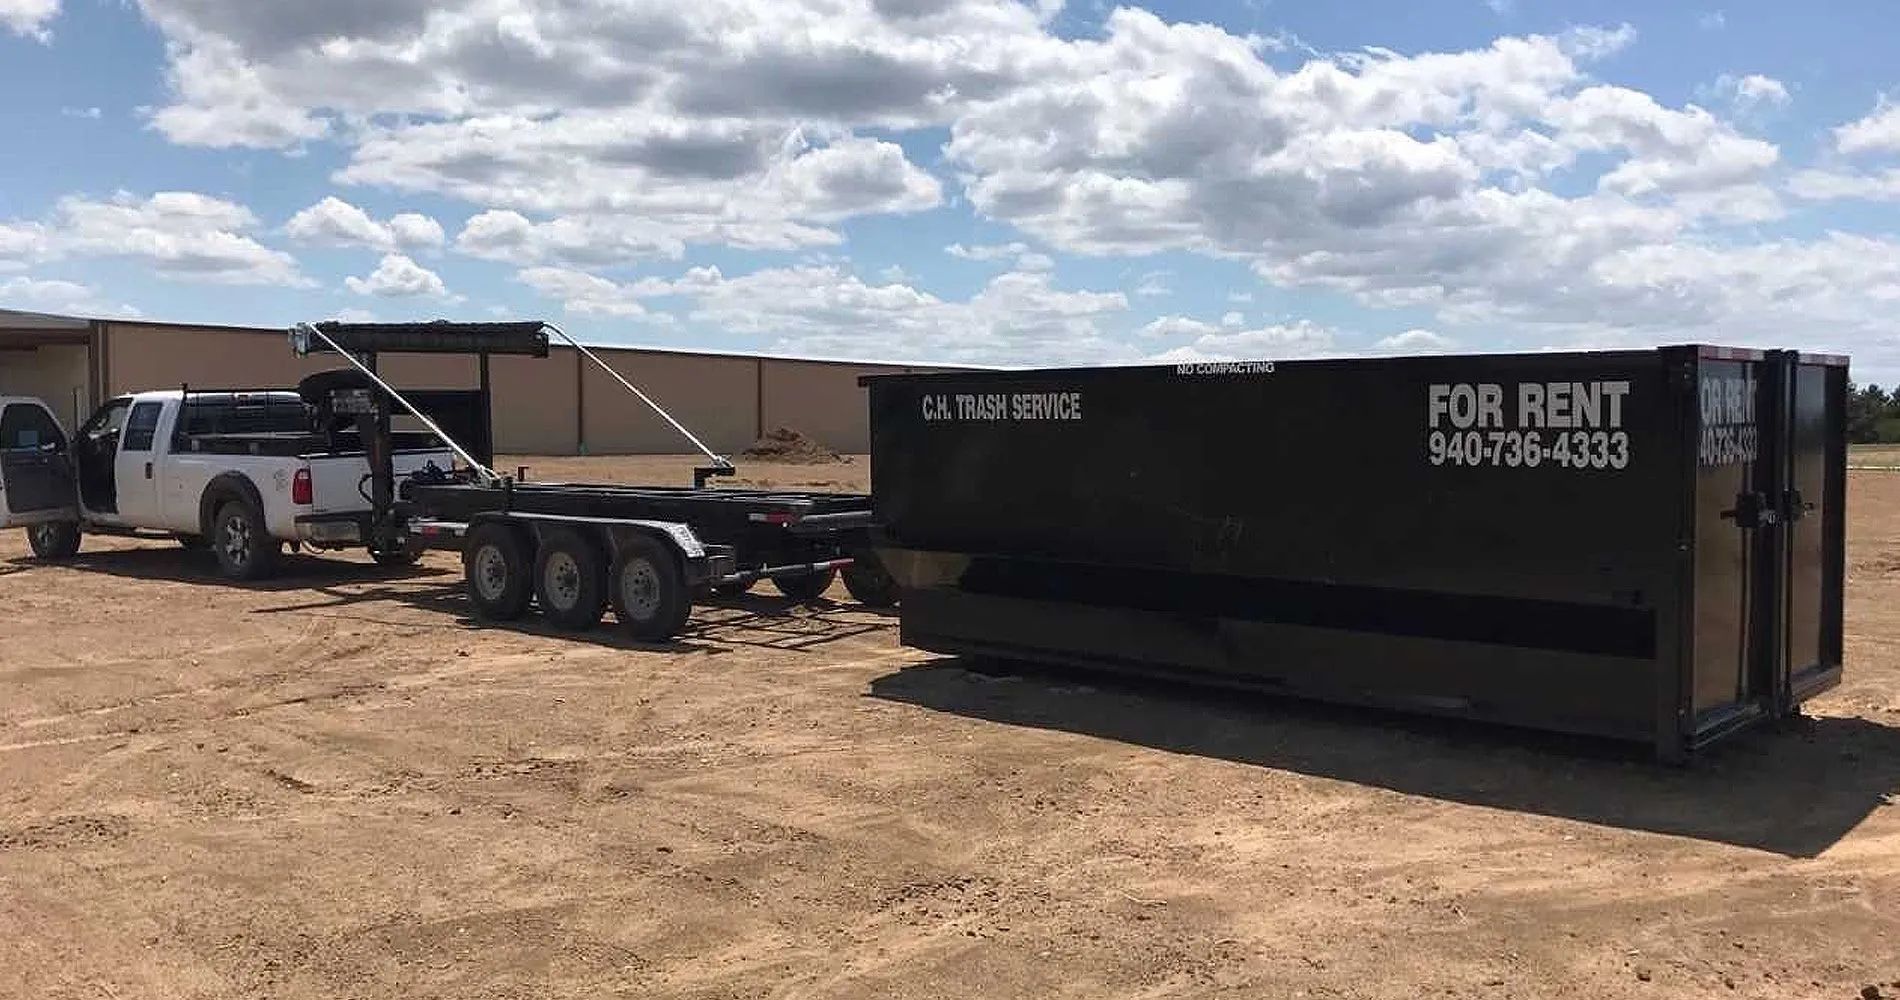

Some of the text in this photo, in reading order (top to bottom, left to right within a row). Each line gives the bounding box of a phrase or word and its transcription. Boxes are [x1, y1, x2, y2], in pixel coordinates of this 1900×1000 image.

[1177, 361, 1275, 375] NO COMPACTING
[923, 393, 1082, 420] C.H. TRASH SERVICE
[1429, 381, 1630, 428] FOR RENT
[1700, 378, 1721, 425] OR
[1429, 431, 1629, 469] 940-736-4333
